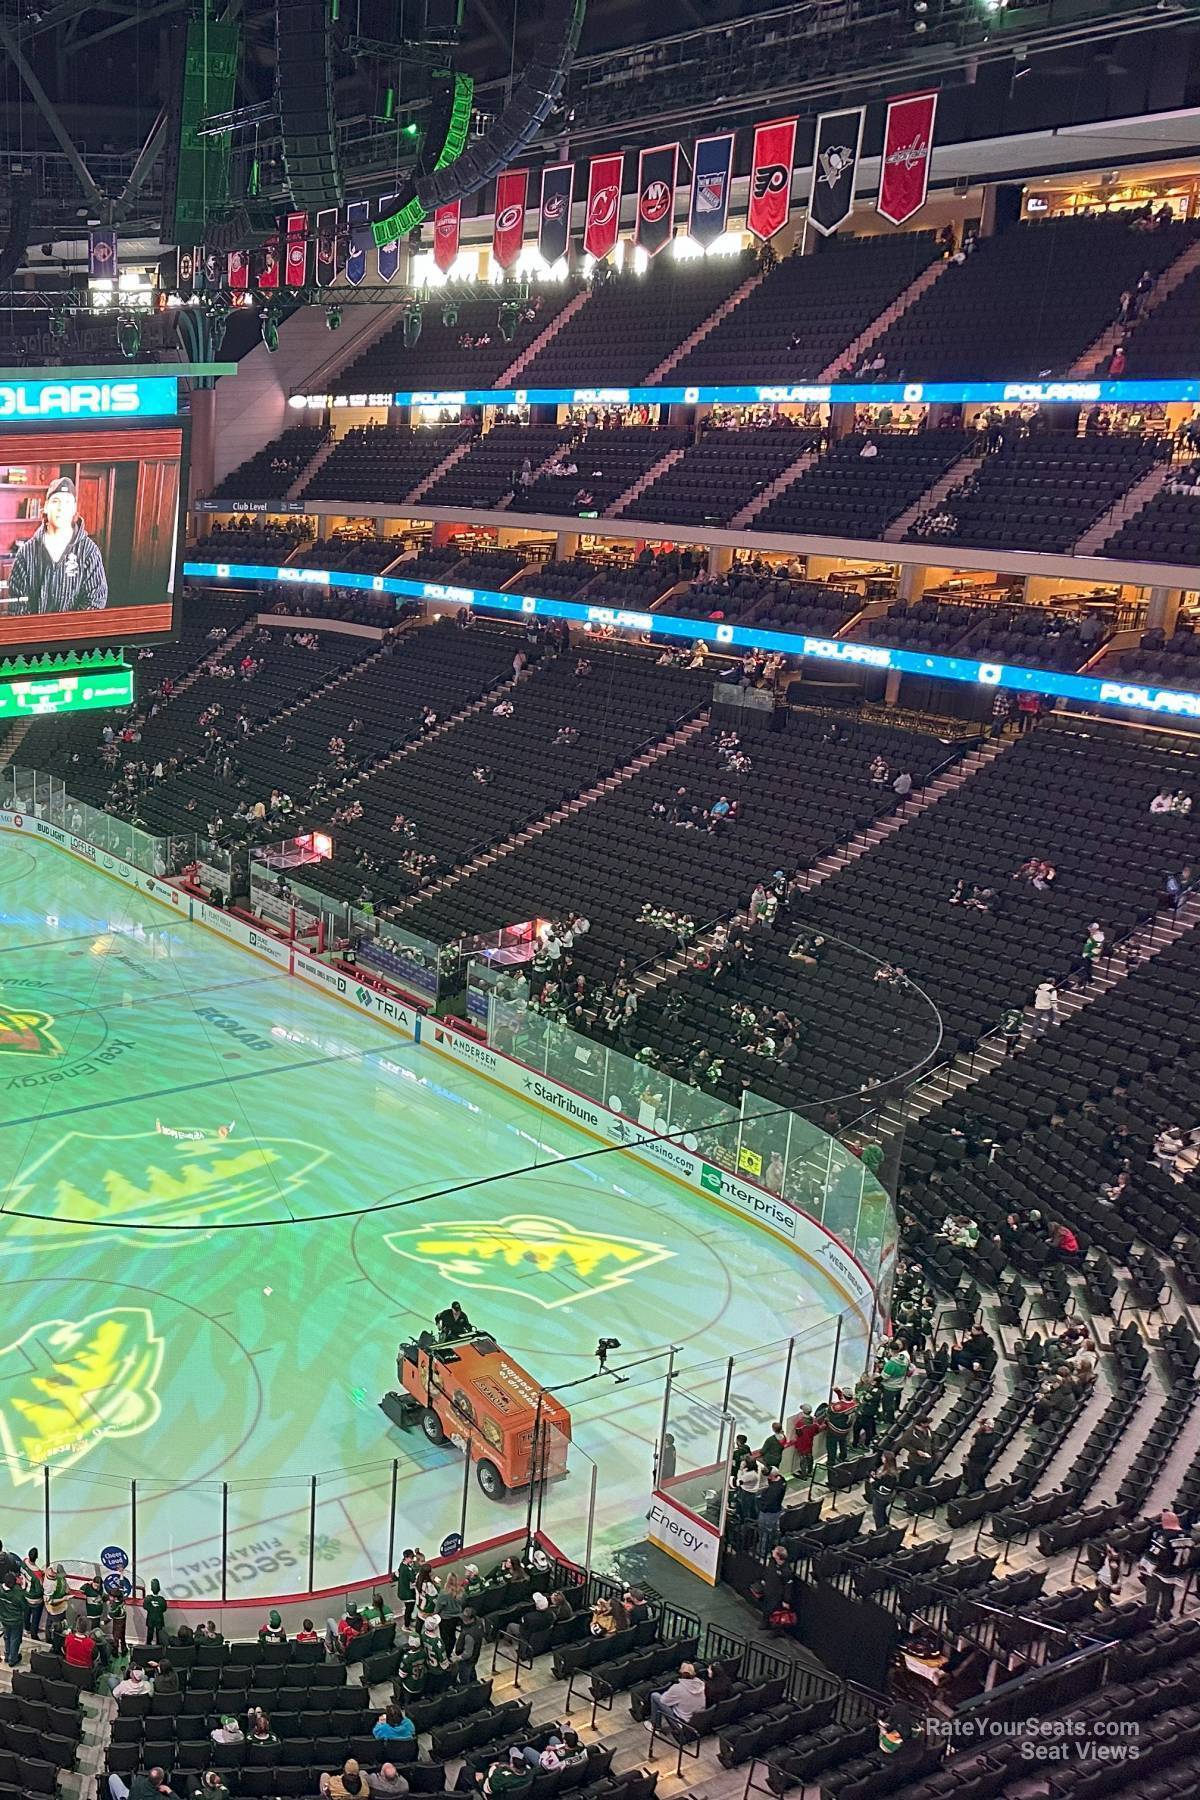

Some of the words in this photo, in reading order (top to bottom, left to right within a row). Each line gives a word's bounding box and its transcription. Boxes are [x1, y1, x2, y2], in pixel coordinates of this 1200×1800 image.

[1003, 379, 1102, 401] POLARIS
[232, 502, 249, 511] Club
[249, 502, 267, 511] Level
[803, 636, 892, 664] POLARIS
[37, 822, 50, 835] BUD
[49, 828, 65, 843] LIGHT
[375, 997, 409, 1026] TRIA
[193, 1006, 274, 1051] ECOLAB
[95, 1038, 137, 1067] Xcel
[453, 1039, 497, 1067] ANDERSEN
[5, 1062, 99, 1091] Energy
[534, 1082, 599, 1126] StarTribune
[706, 1173, 794, 1228] enterprise
[650, 1505, 704, 1552] Energy
[176, 1537, 283, 1576] FINANCIAL
[161, 1549, 297, 1600] securia
